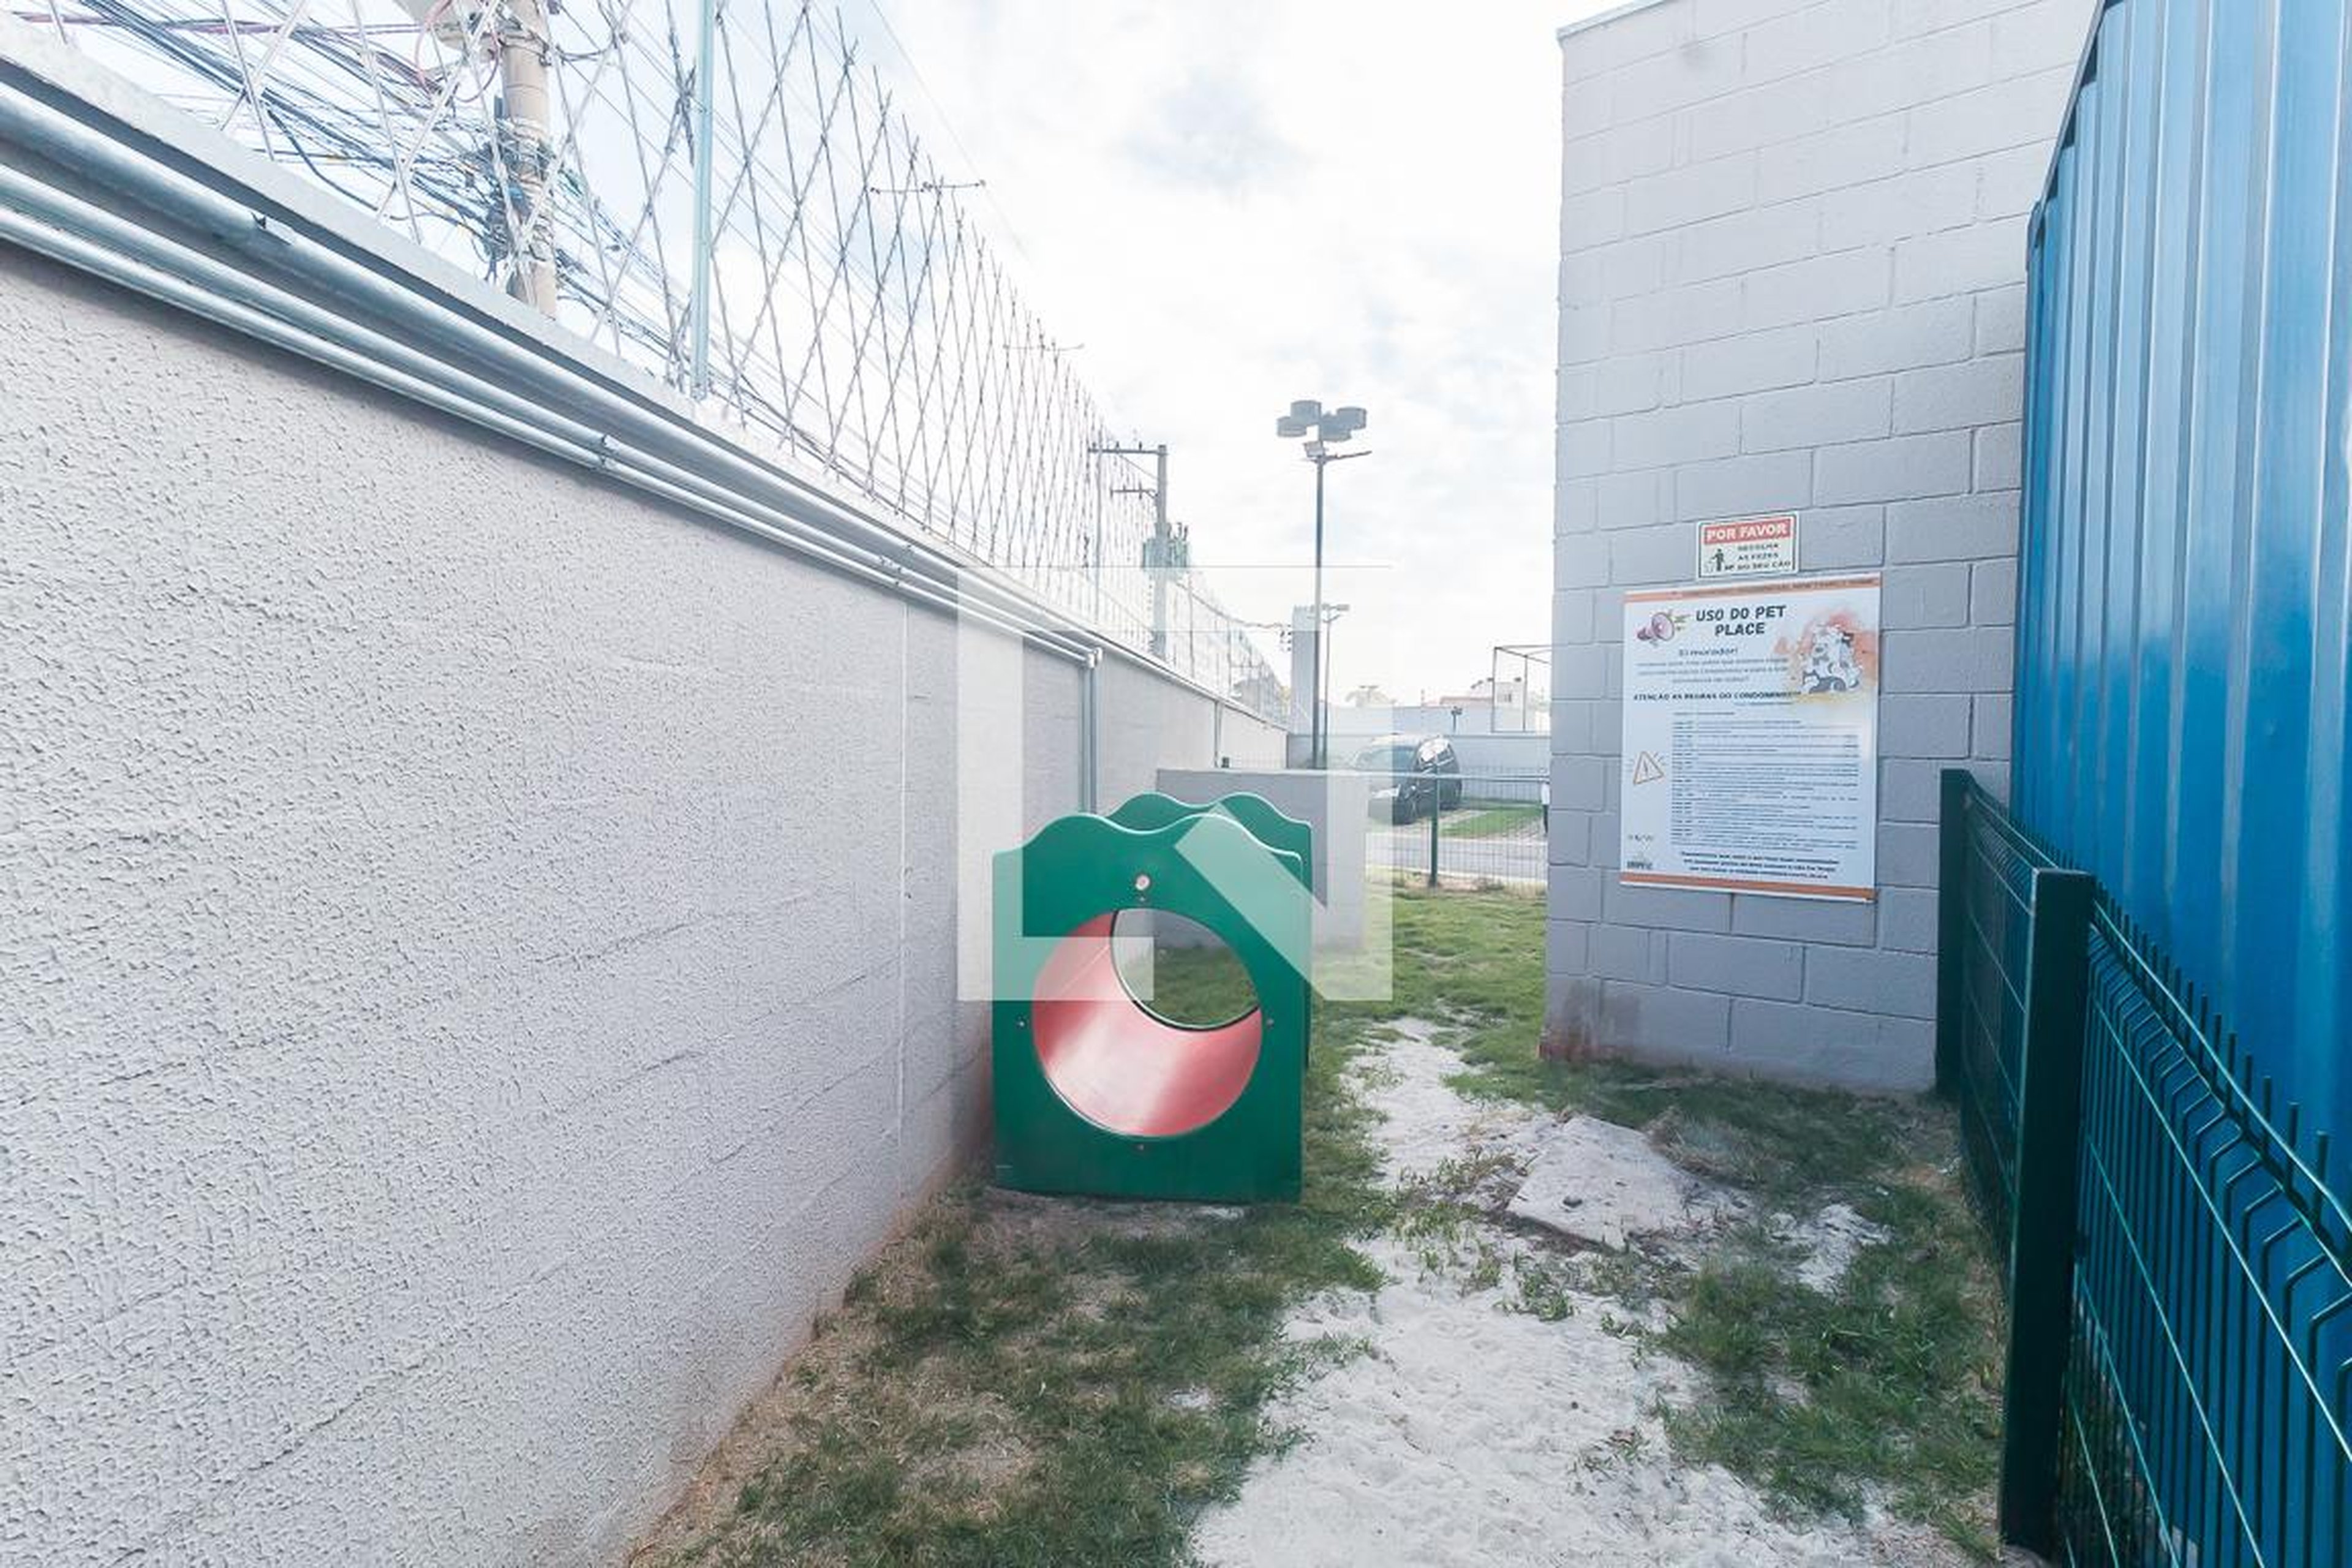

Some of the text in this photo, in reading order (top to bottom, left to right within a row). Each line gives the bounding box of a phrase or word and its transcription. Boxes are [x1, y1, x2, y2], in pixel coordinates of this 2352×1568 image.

[1706, 522, 1787, 541] POR FAVOR
[1696, 605, 1787, 622] USO DO PET
[1715, 622, 1765, 636] PLACE
